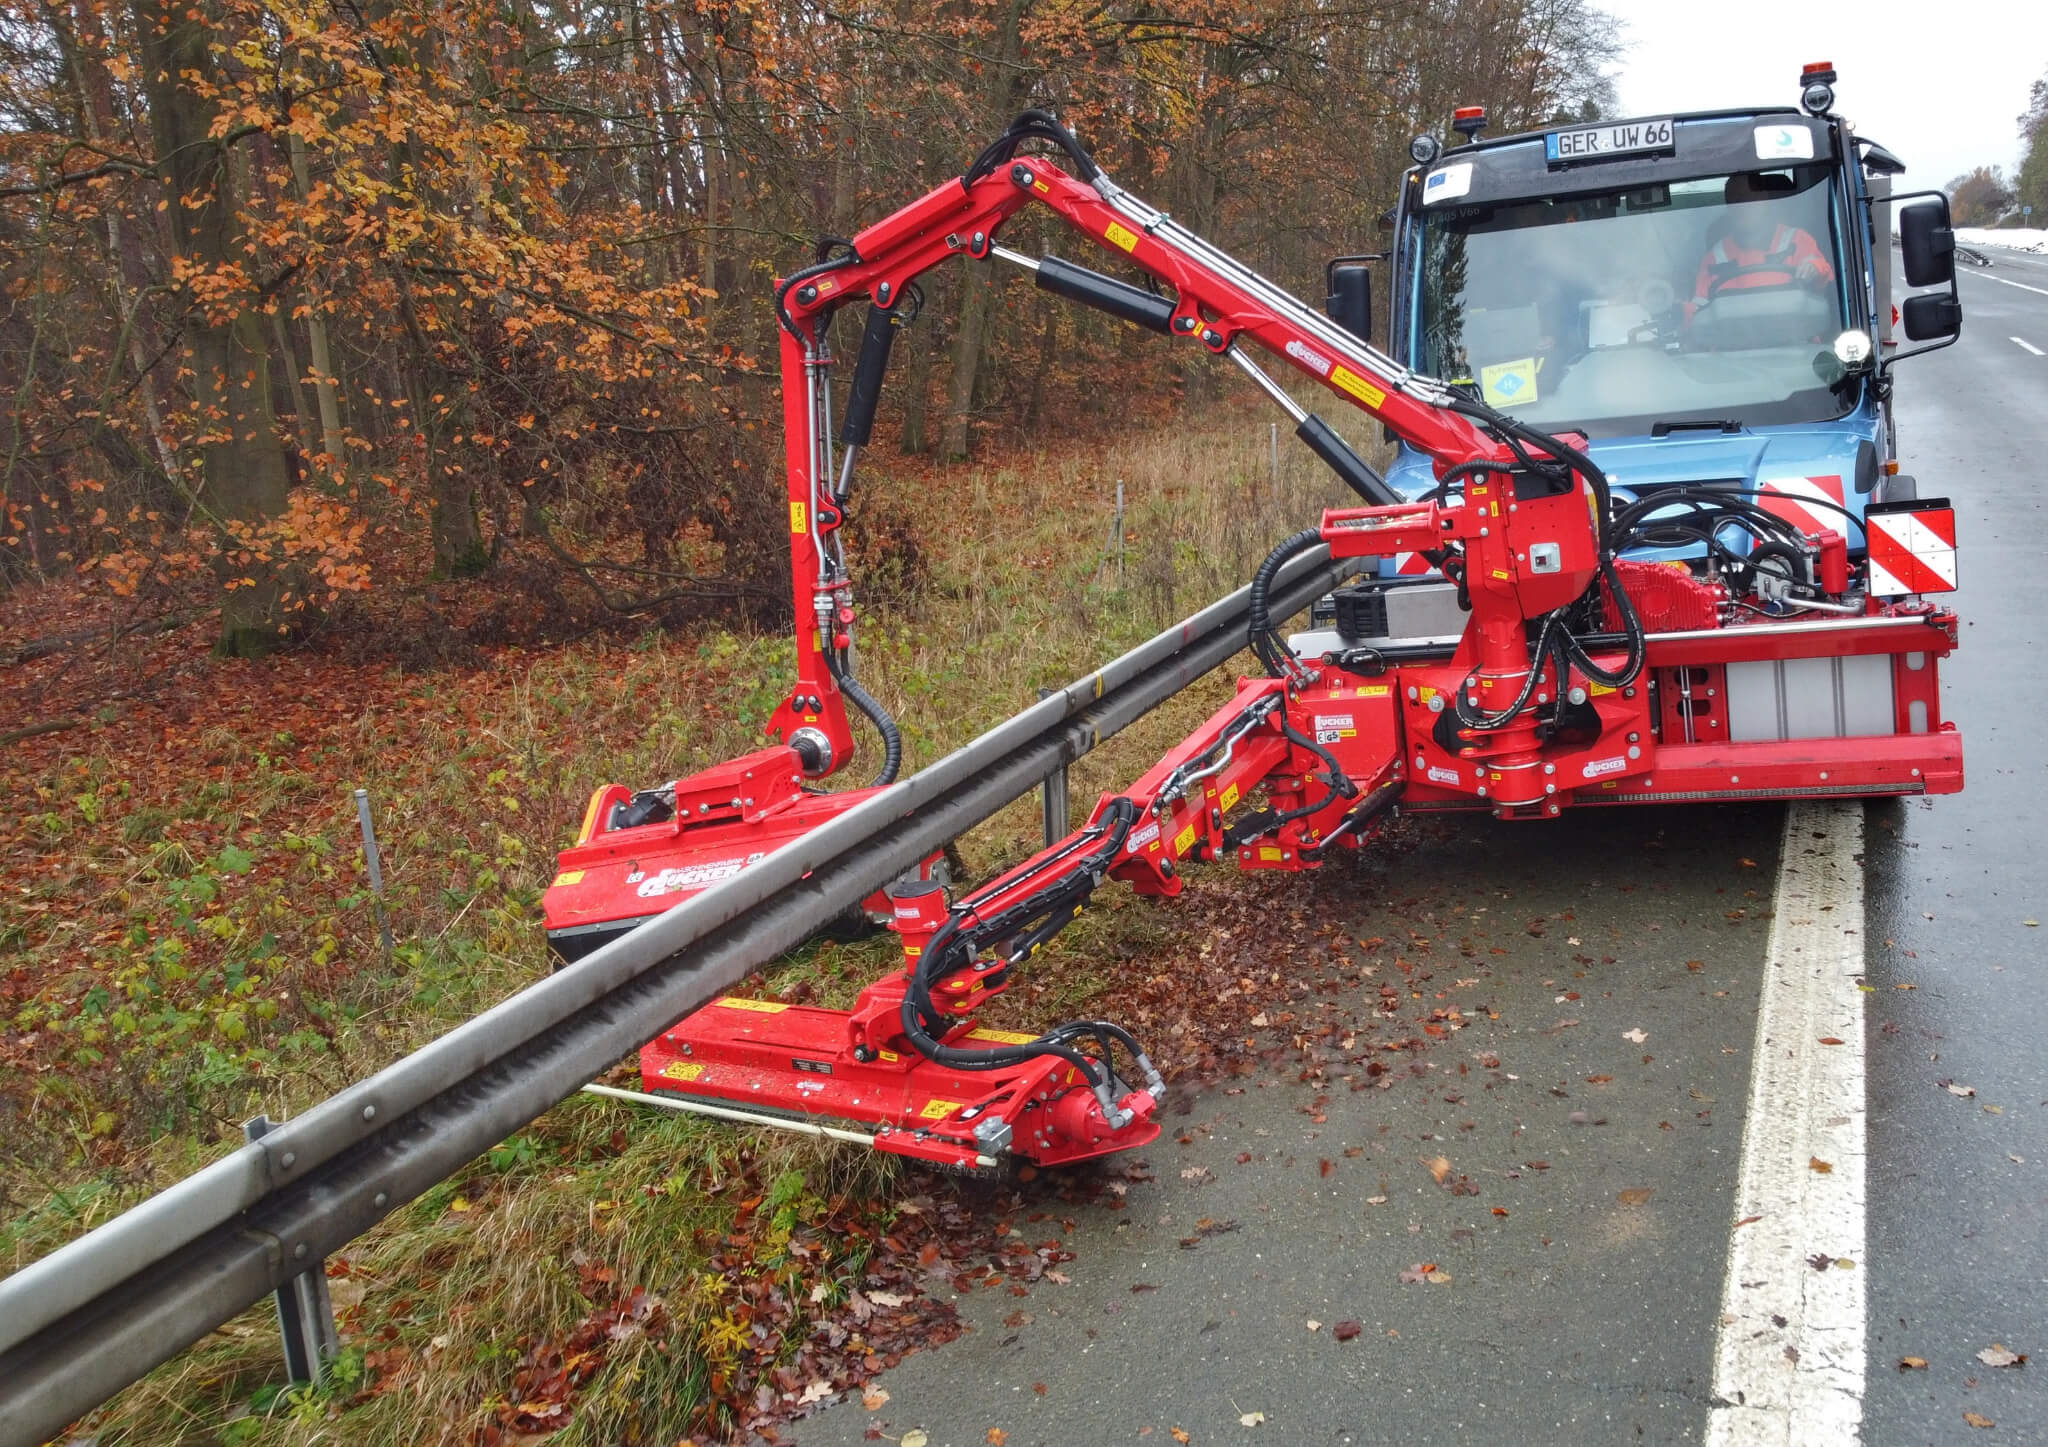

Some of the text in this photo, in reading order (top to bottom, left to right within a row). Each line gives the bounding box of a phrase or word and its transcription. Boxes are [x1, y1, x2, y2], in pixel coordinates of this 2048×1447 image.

[1559, 123, 1670, 155] GER UW 66
